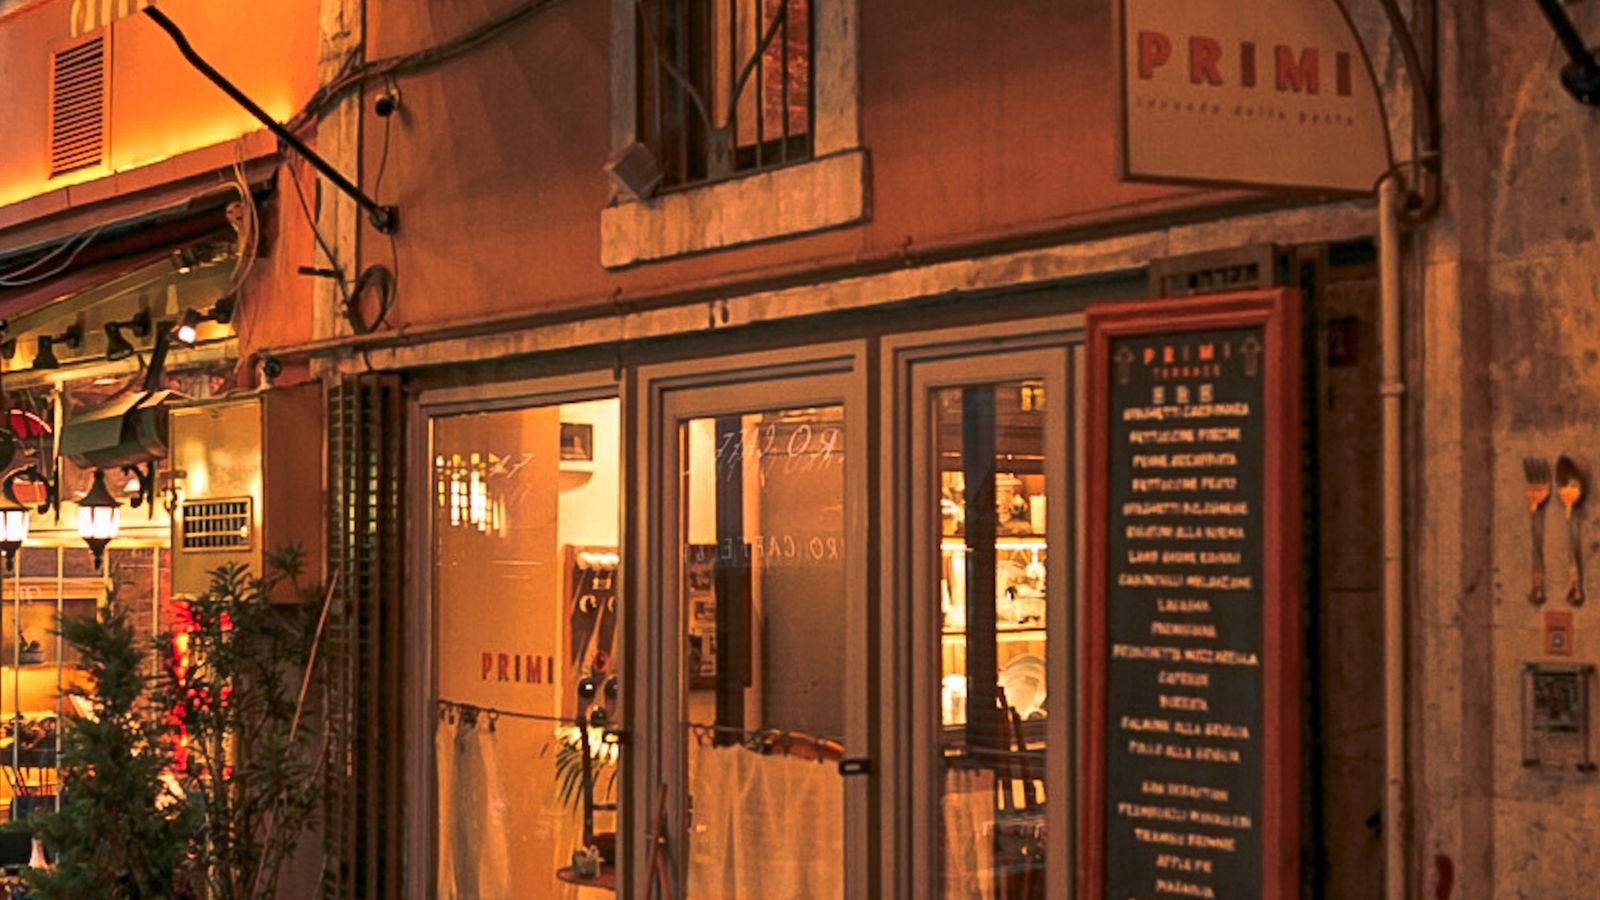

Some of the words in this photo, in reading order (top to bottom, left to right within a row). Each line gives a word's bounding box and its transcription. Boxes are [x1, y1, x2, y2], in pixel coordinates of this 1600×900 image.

[1137, 30, 1352, 97] PRIMI
[1143, 341, 1231, 365] PRIMI
[481, 651, 555, 685] PRIMI
